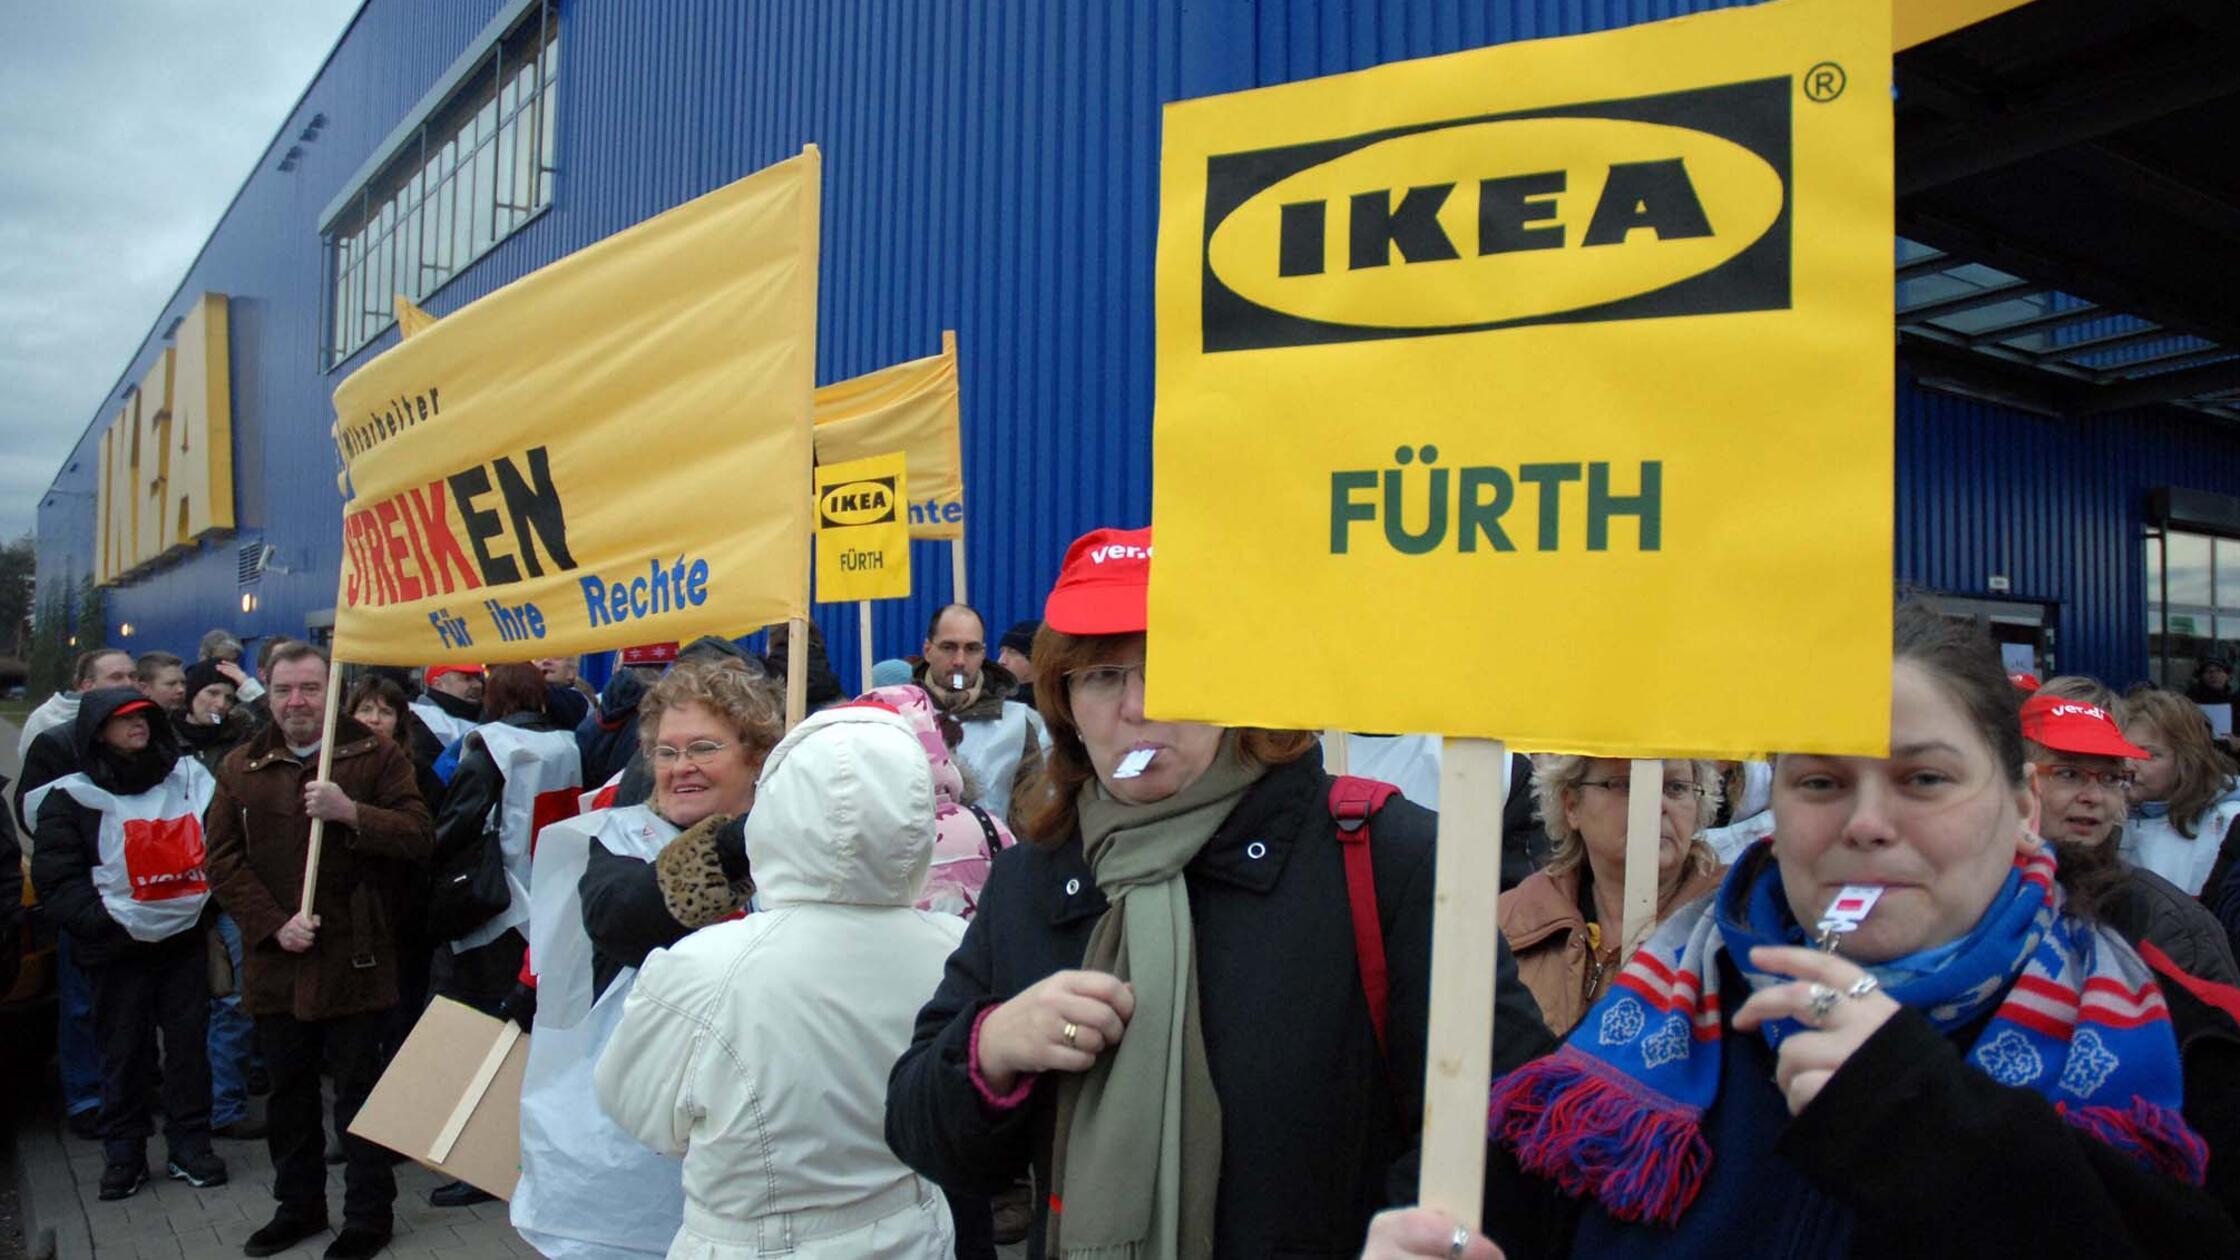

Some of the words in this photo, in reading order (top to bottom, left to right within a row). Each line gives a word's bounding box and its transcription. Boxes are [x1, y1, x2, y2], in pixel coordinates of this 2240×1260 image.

[1278, 157, 1715, 278] IKEA
[94, 292, 234, 586] IKEA
[342, 387, 439, 460] Mitarbeiter
[344, 445, 578, 609] STREIKEN
[830, 491, 887, 513] IKEA
[907, 498, 962, 524] hte
[1330, 445, 1663, 555] FÜRTH
[840, 548, 884, 572] FÜRTH
[1091, 545, 1153, 565] ver.
[428, 608, 474, 649] Für
[483, 598, 547, 642] ihre
[579, 554, 709, 628] Rechte
